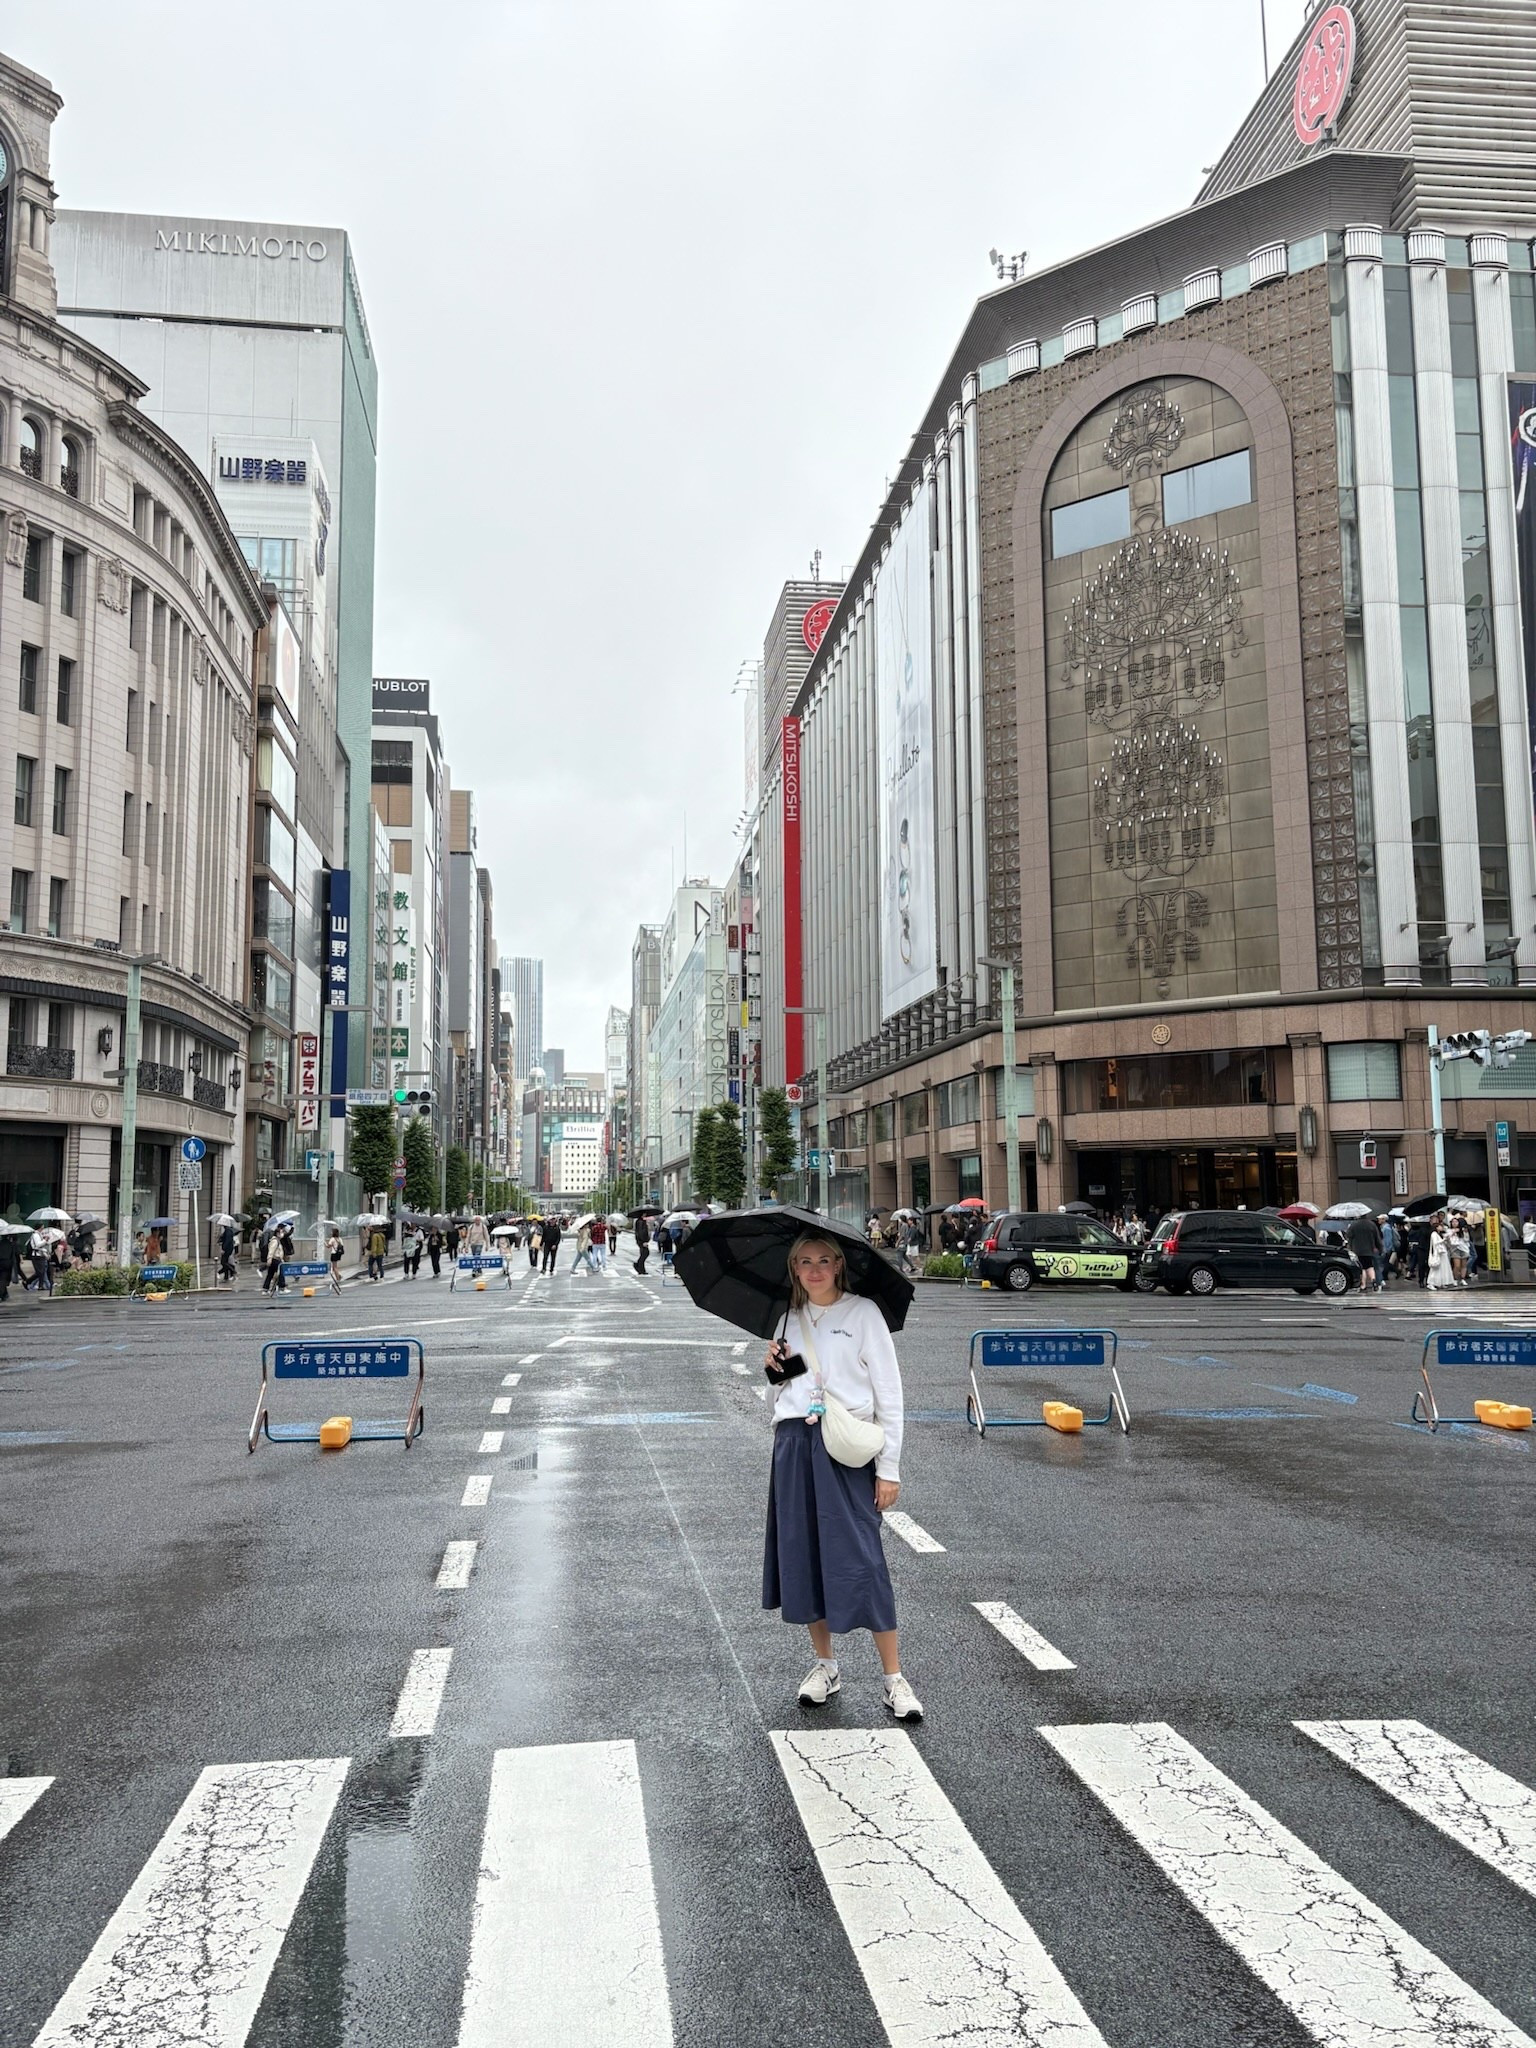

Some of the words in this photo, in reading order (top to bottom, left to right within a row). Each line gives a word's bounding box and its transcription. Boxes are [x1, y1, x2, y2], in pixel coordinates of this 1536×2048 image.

[155, 230, 328, 262] MIKIMOTO
[219, 456, 306, 482] 山野楽器
[371, 680, 428, 693] HUBLOT
[786, 724, 797, 822] MITSUKOSHI
[393, 890, 409, 981] 教文館
[331, 915, 348, 1006] 山野楽器
[391, 1032, 407, 1053] 本
[284, 1352, 401, 1365] 歩行者天国実施中
